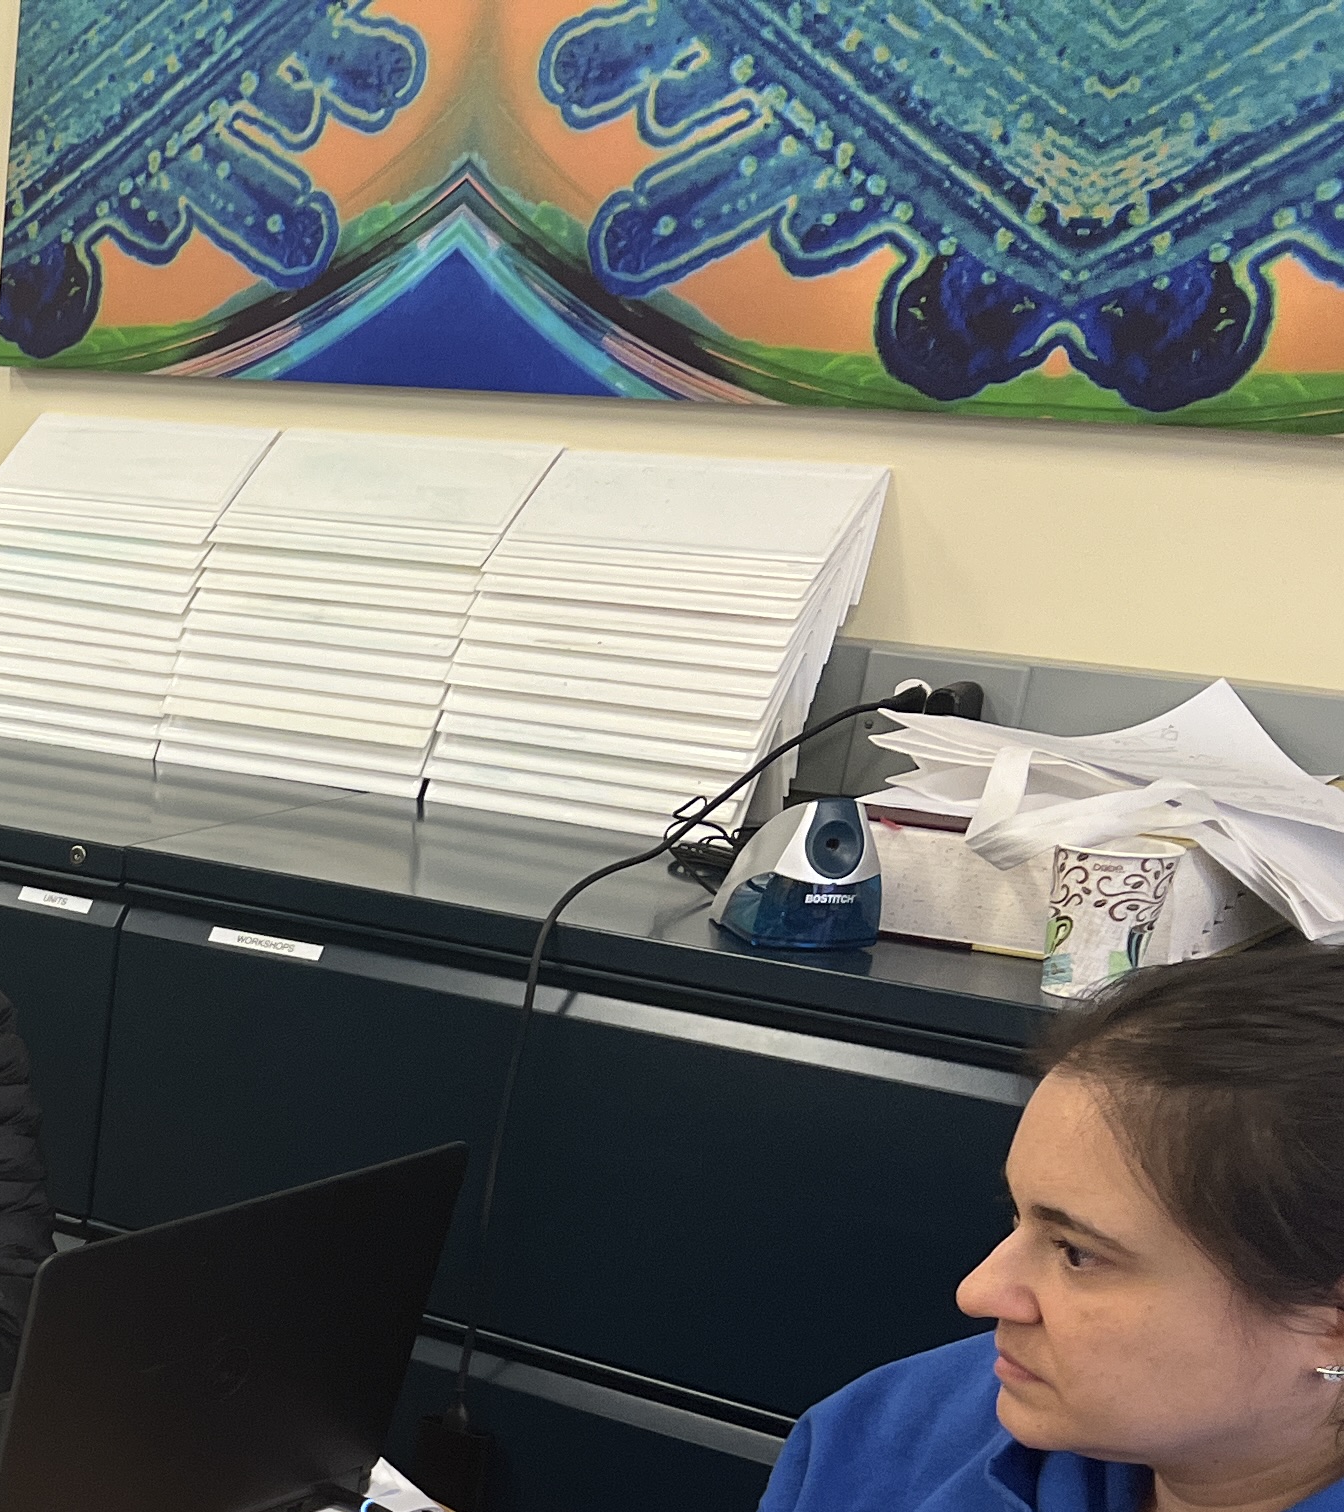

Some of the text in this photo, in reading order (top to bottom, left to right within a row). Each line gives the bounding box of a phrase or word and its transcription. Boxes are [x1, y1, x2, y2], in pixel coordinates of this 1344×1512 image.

[43, 893, 68, 907] UNITS
[804, 893, 856, 905] BOSTITCH
[236, 933, 296, 953] WORKSHOPS
